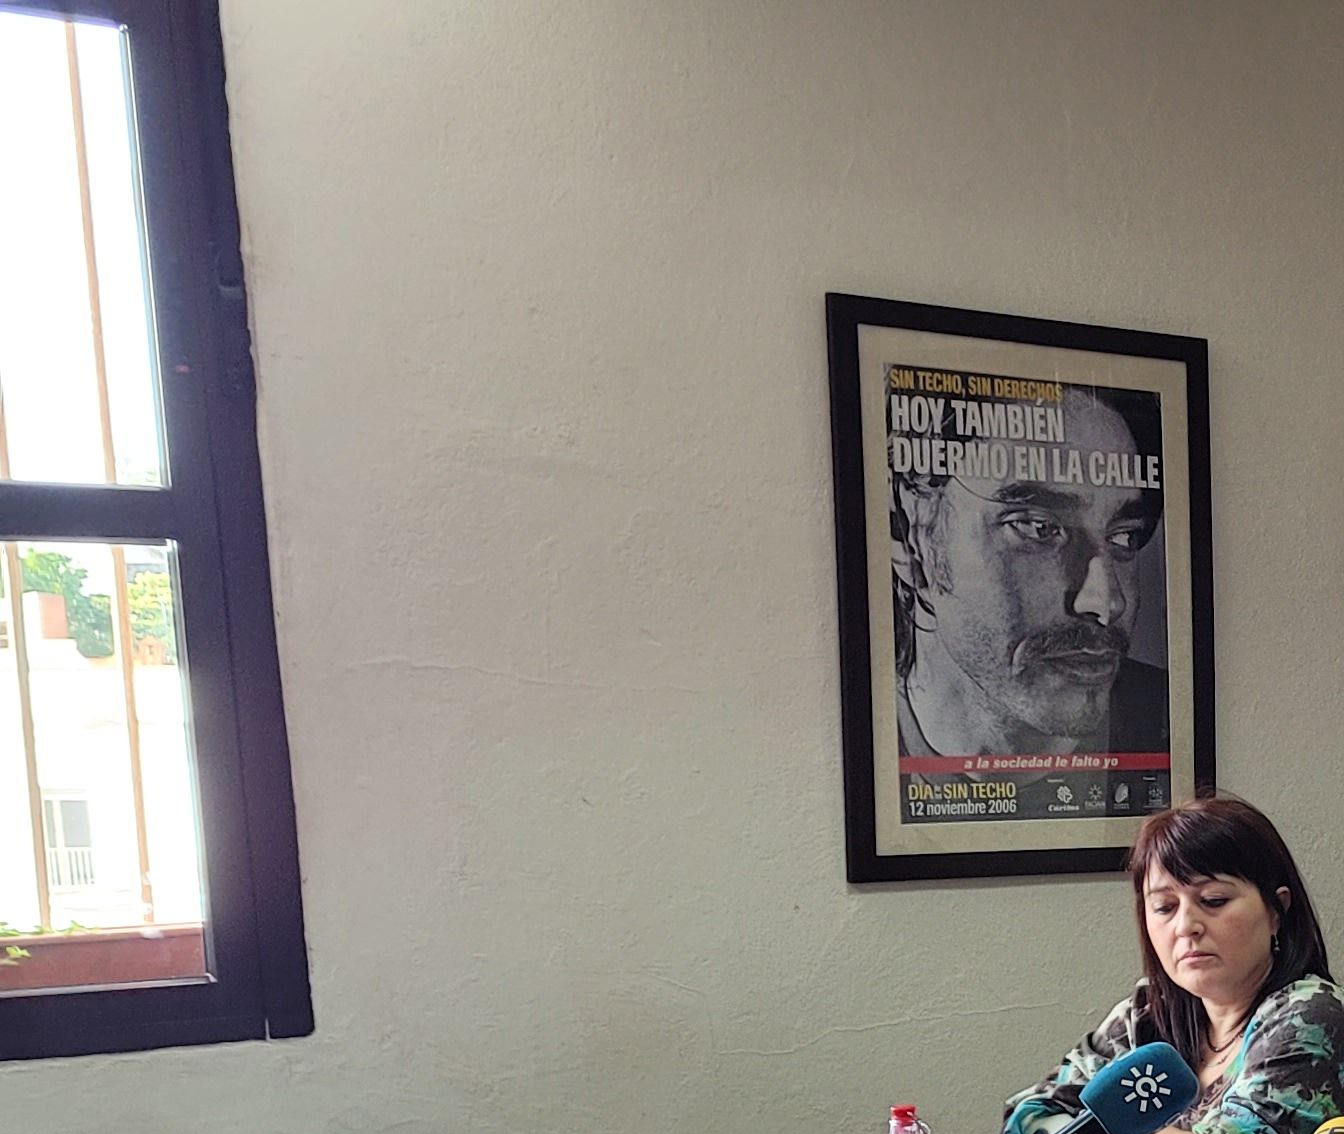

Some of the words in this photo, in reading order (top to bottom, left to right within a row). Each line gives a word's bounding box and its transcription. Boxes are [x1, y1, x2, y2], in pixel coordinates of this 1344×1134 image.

[890, 371, 915, 390] SIN
[917, 374, 966, 398] TECHO,
[968, 378, 993, 397] SIN
[997, 381, 1063, 401] DERECHOS
[890, 394, 946, 435] HOY
[951, 399, 1066, 443] TAMBIÉN
[893, 437, 1010, 480] DUERMO
[1014, 446, 1047, 482] EN
[1052, 449, 1084, 484] LA
[1088, 452, 1161, 489] CALLE
[977, 757, 990, 769] la
[993, 756, 1052, 769] sociedad
[1055, 756, 1068, 768] le
[1103, 757, 1119, 770] yo
[942, 783, 968, 798] SIN
[970, 782, 1016, 798] TECHO
[909, 801, 924, 816] 12
[927, 799, 986, 816] noviembre
[988, 799, 1017, 814] 2006
